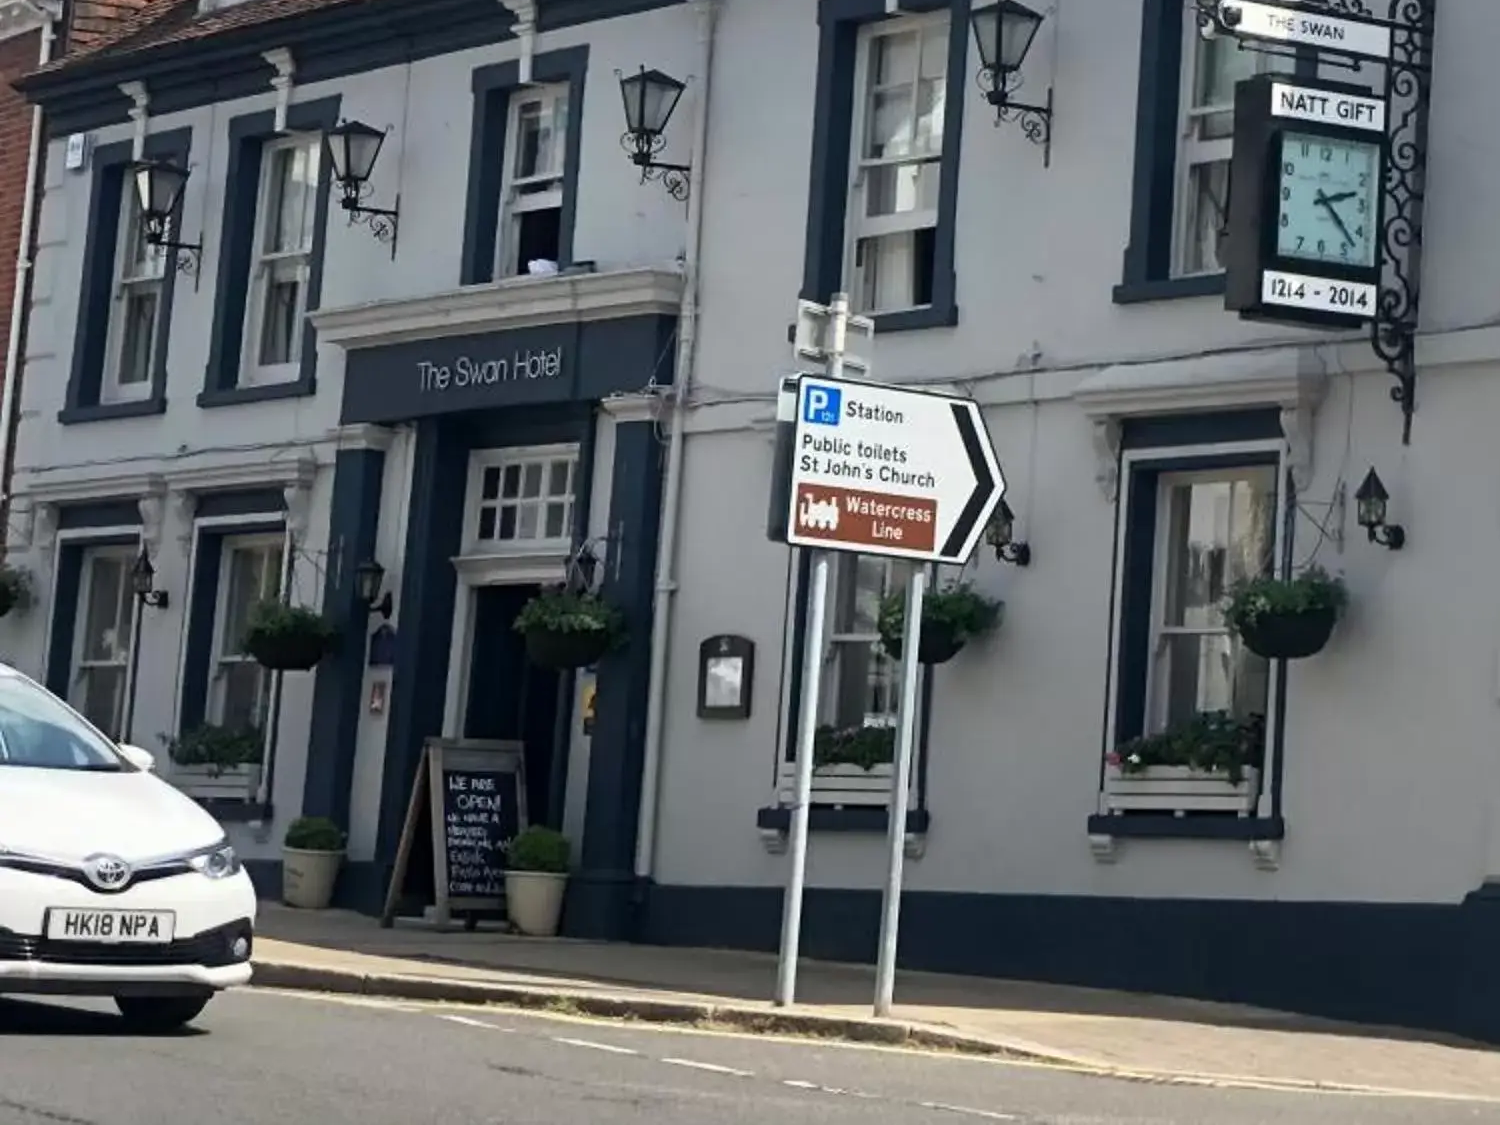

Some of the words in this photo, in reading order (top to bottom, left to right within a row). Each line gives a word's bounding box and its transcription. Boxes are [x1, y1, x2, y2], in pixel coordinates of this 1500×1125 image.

[1266, 13, 1295, 33] THE
[1301, 19, 1346, 41] SWAN
[1280, 90, 1329, 116] NATT
[1336, 100, 1377, 123] GIFT
[1271, 278, 1306, 299] 1214
[1329, 286, 1369, 308] 2014
[416, 360, 451, 391] The
[455, 356, 508, 386] Swan
[513, 346, 562, 380] Hotel
[808, 389, 829, 420] P
[845, 399, 905, 424] Station
[802, 433, 852, 457] Public
[857, 440, 908, 464] toilets
[799, 455, 819, 474] St
[823, 458, 874, 481] John's
[878, 465, 936, 488] Church
[845, 496, 932, 523] Watercress
[871, 520, 903, 541] Line
[64, 913, 113, 936] HK18
[119, 914, 159, 937] NPA
